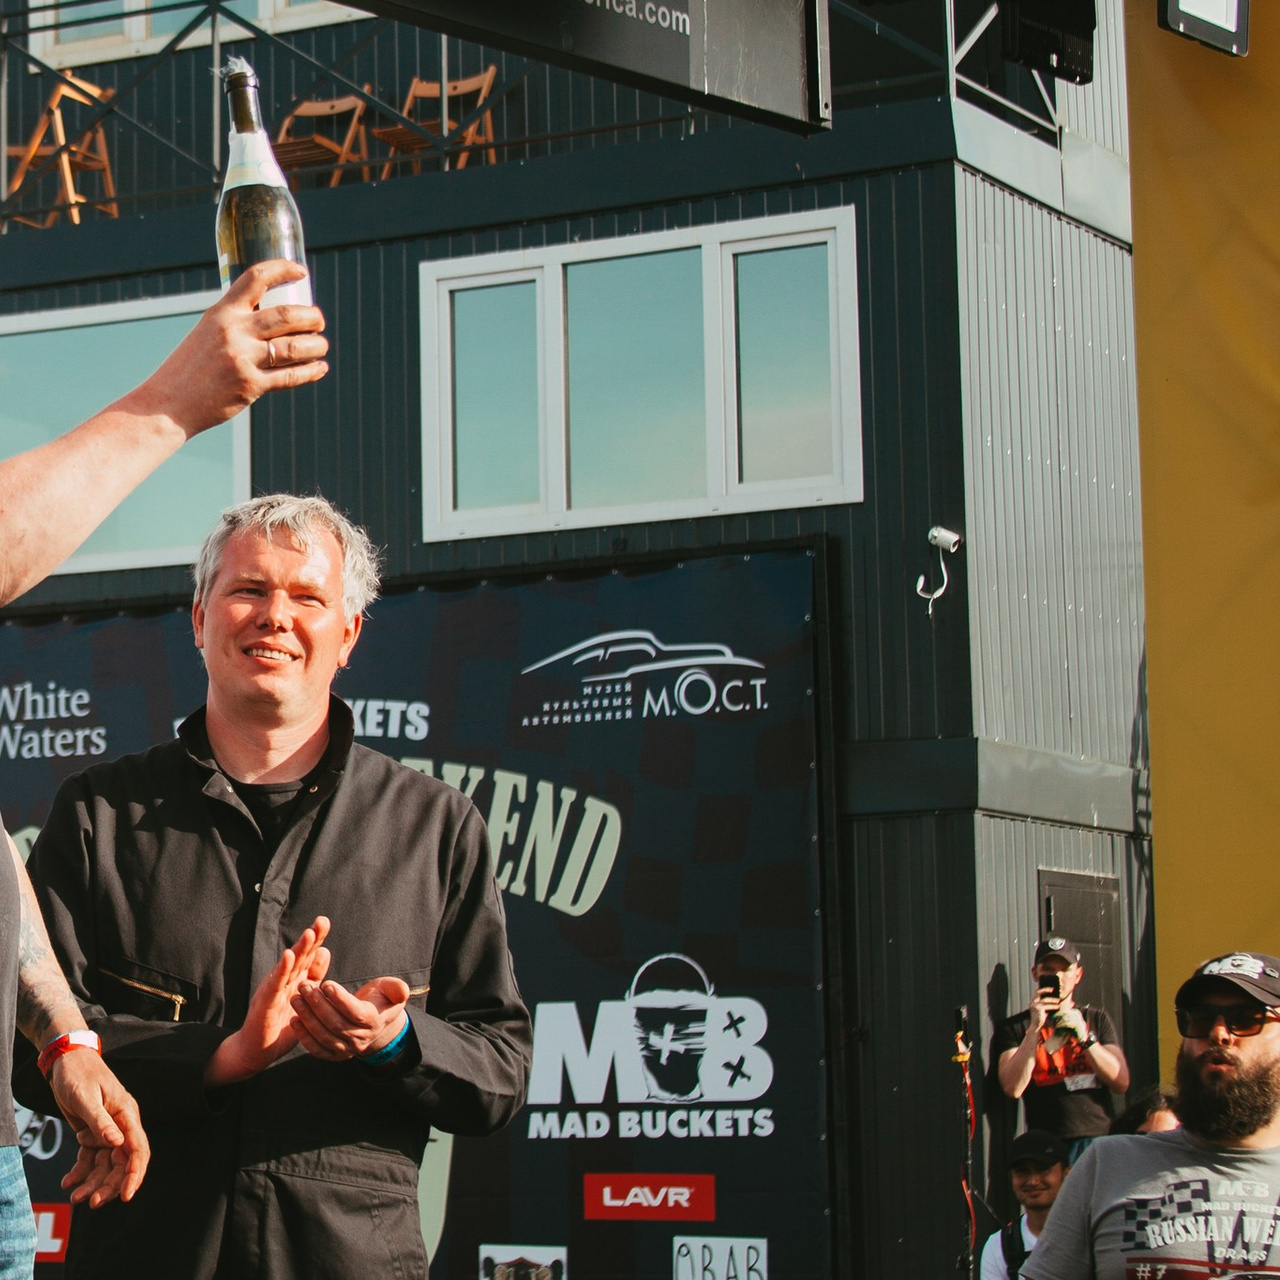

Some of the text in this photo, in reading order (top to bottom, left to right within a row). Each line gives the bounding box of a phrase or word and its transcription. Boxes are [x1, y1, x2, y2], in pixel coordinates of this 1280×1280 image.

[527, 1108, 775, 1139] MAD BUCKETS
[602, 1185, 692, 1208] LAVR
[1145, 1215, 1235, 1250] RUSSIAN
[1214, 1247, 1268, 1262] DRAGS
